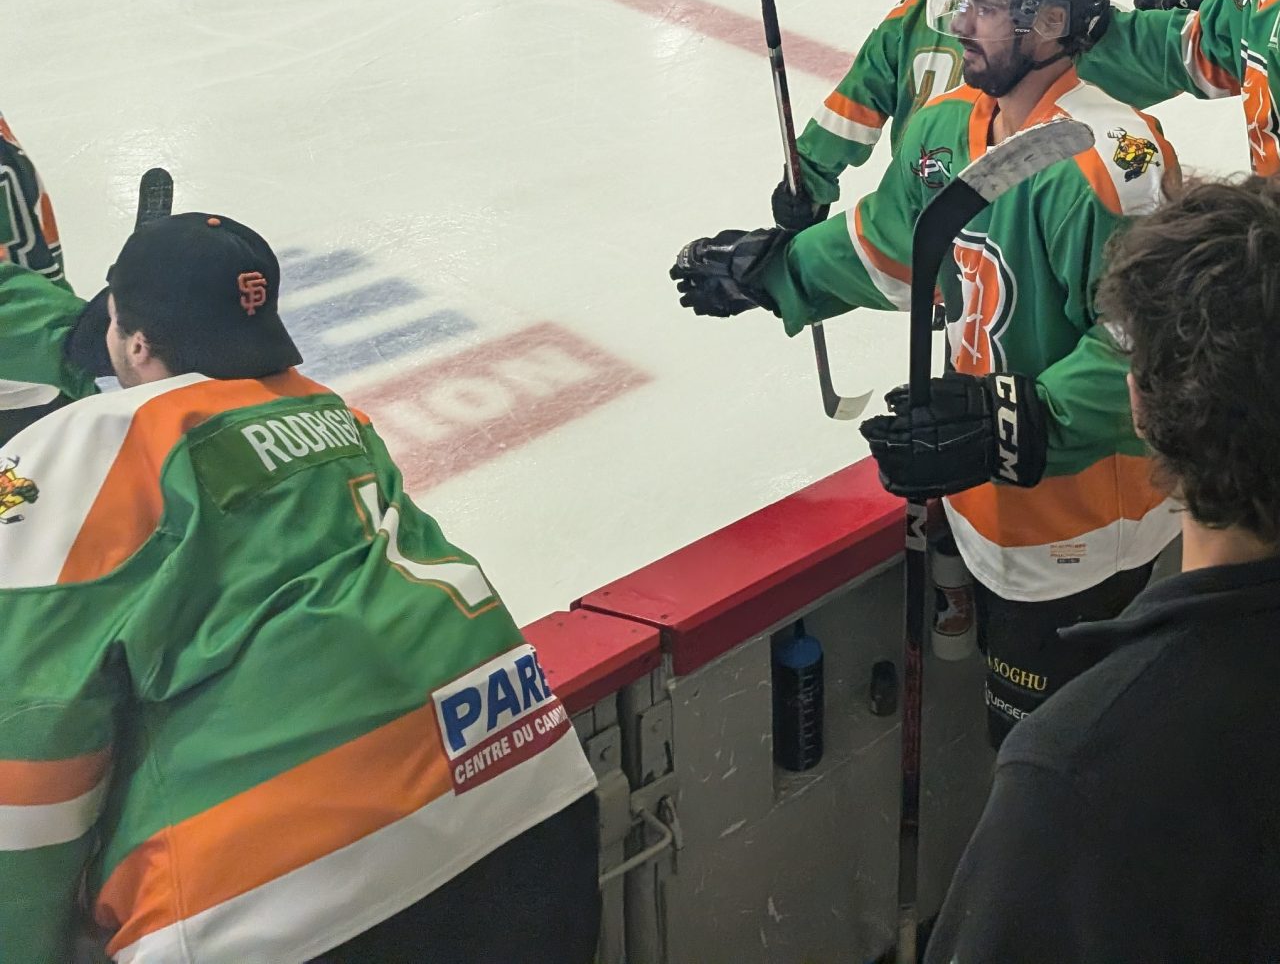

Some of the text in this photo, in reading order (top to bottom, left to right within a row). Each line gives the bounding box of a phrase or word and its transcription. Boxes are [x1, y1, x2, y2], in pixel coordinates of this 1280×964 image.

[994, 375, 1021, 485] CCM
[992, 656, 1048, 691] SOGHU
[454, 735, 512, 785] CENTRE
[512, 722, 534, 749] DU
